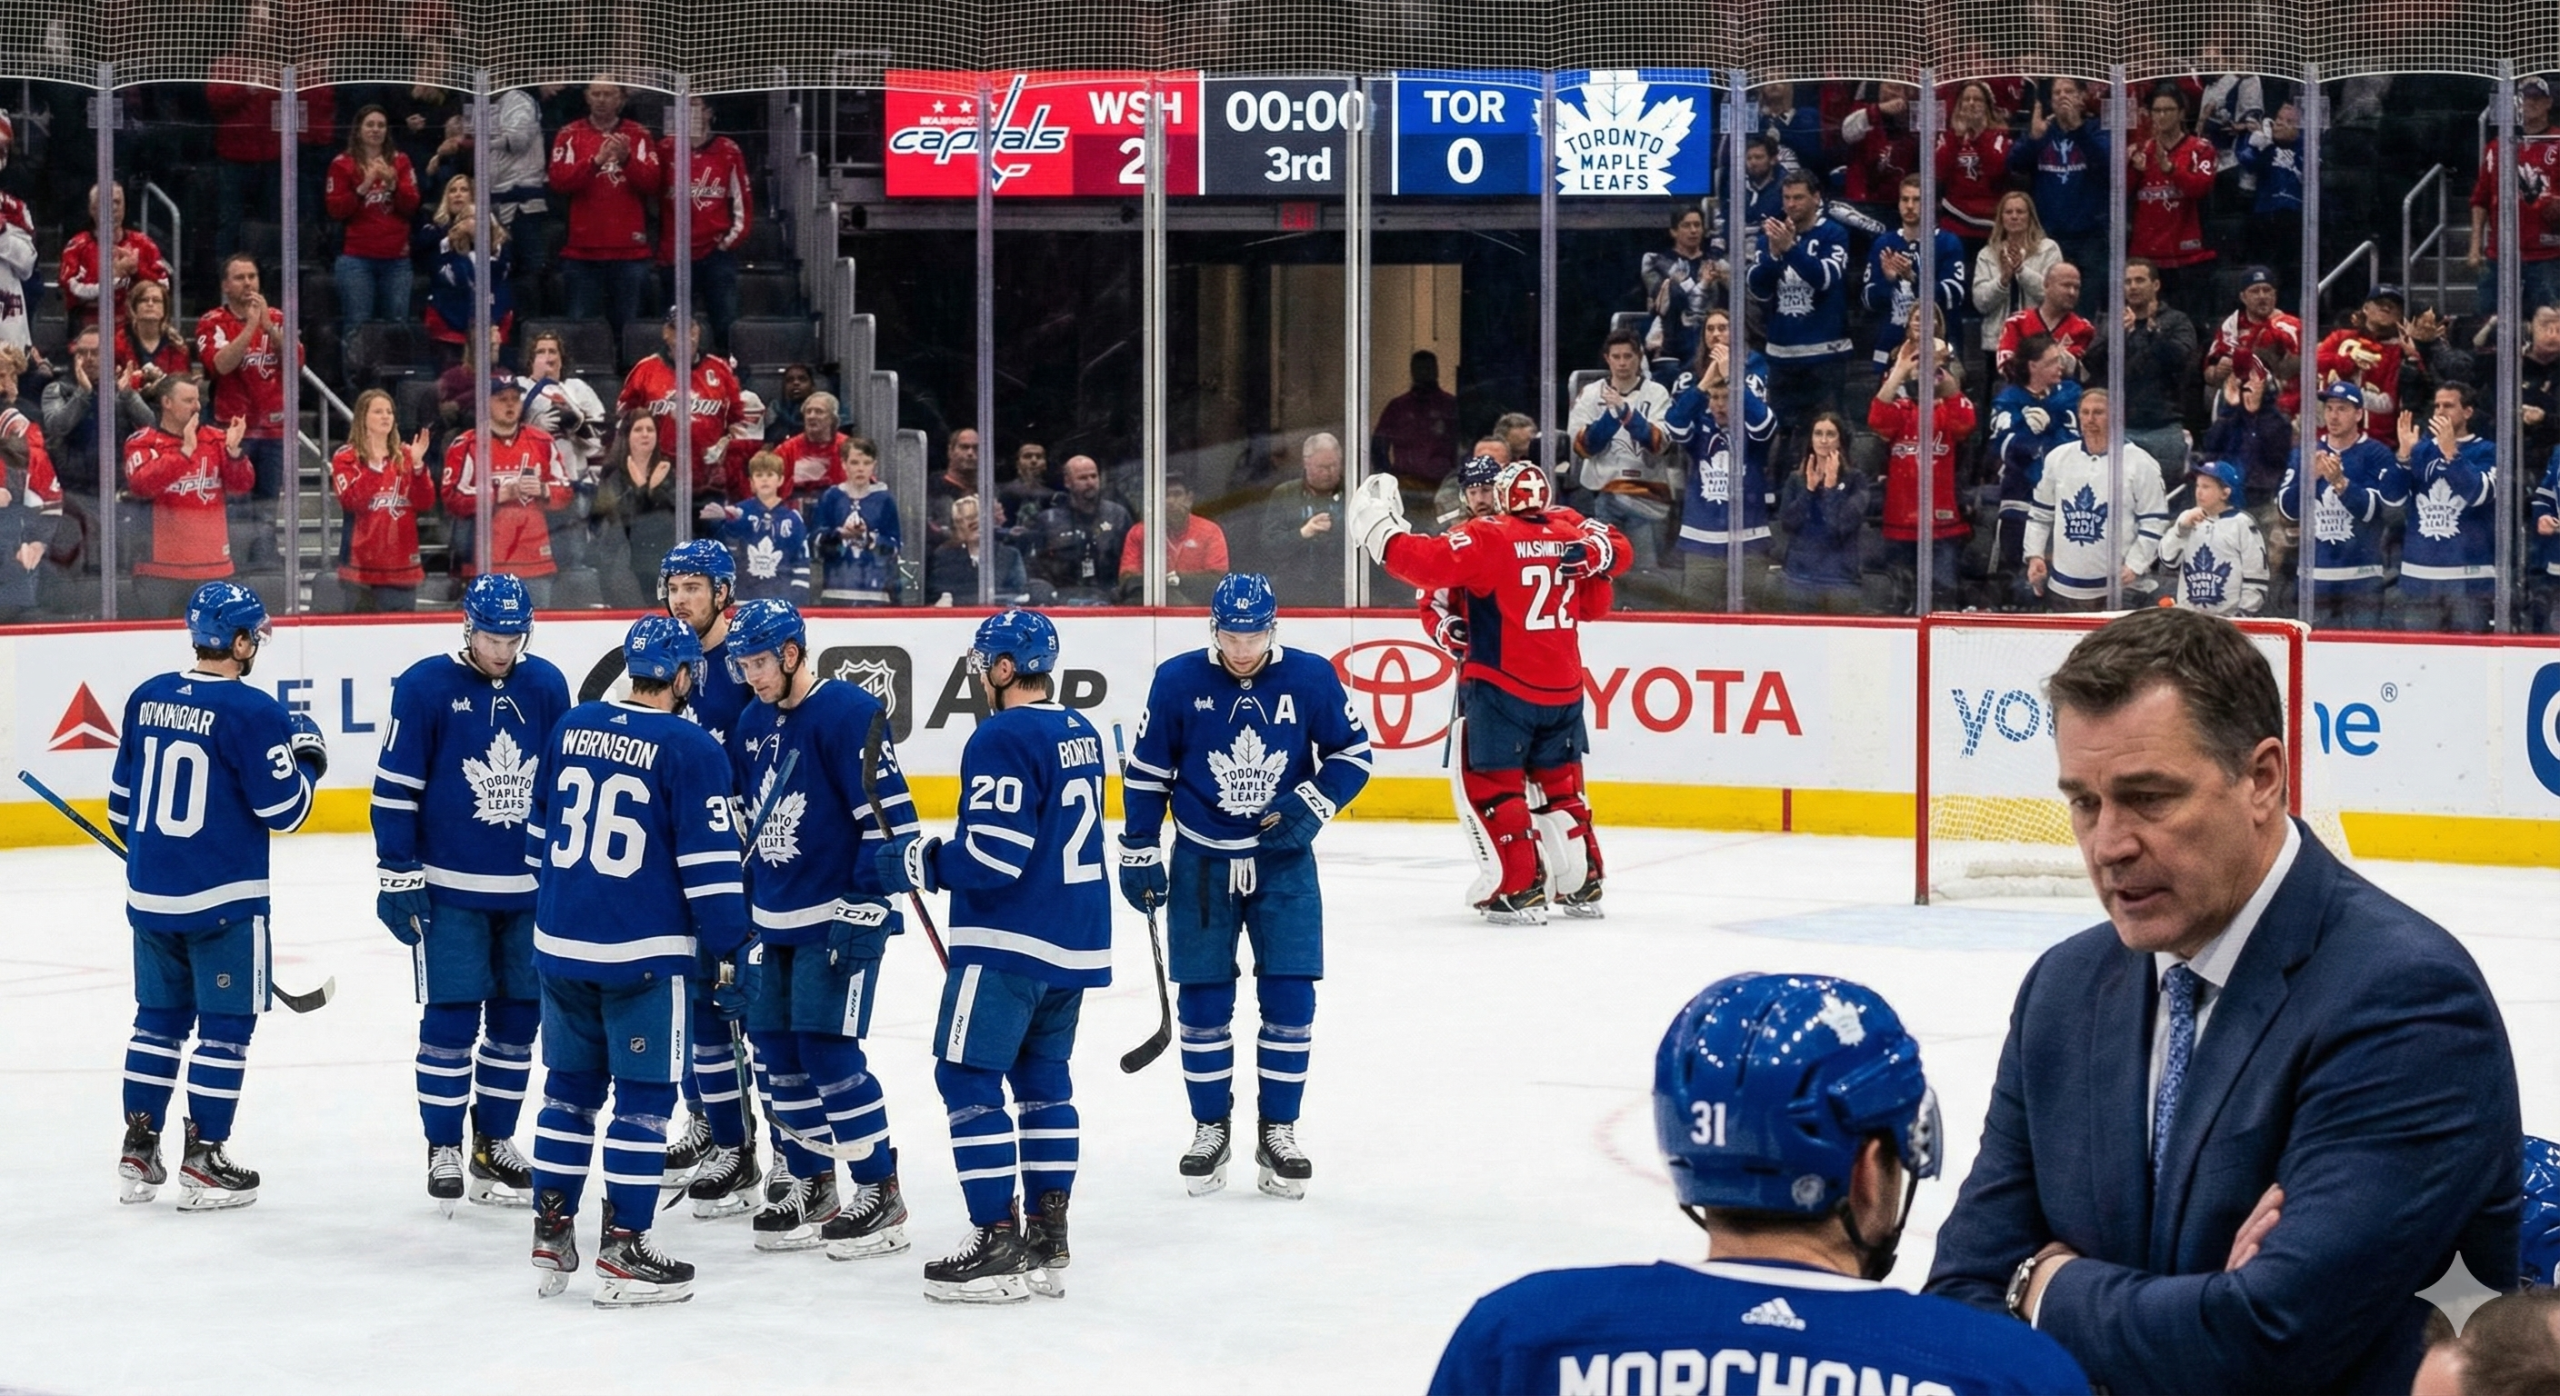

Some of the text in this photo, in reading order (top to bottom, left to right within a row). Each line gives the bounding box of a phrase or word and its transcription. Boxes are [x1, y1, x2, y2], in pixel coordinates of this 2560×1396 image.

[889, 74, 1070, 165] captals
[1088, 91, 1182, 125] WSH
[1225, 90, 1365, 133] 00:00
[1423, 90, 1506, 124] TOR
[1564, 127, 1664, 155] TORONTO
[1118, 137, 1147, 185] 2
[1264, 147, 1332, 183] 3rd
[1447, 137, 1485, 184] 0
[1580, 154, 1649, 171] MAPLE
[1580, 174, 1649, 191] LEAFS
[1273, 694, 1298, 725] A
[1950, 688, 2055, 759] yo
[135, 735, 210, 839] 10
[487, 799, 525, 810] LEAFS
[969, 775, 1024, 814] 20
[1230, 792, 1267, 802] LEAFS
[551, 767, 651, 879] 36
[705, 795, 733, 833] 3
[1061, 775, 1104, 885] 2
[379, 876, 425, 892] CCM
[836, 905, 881, 924] CCM
[1690, 1101, 1727, 1147] 31
